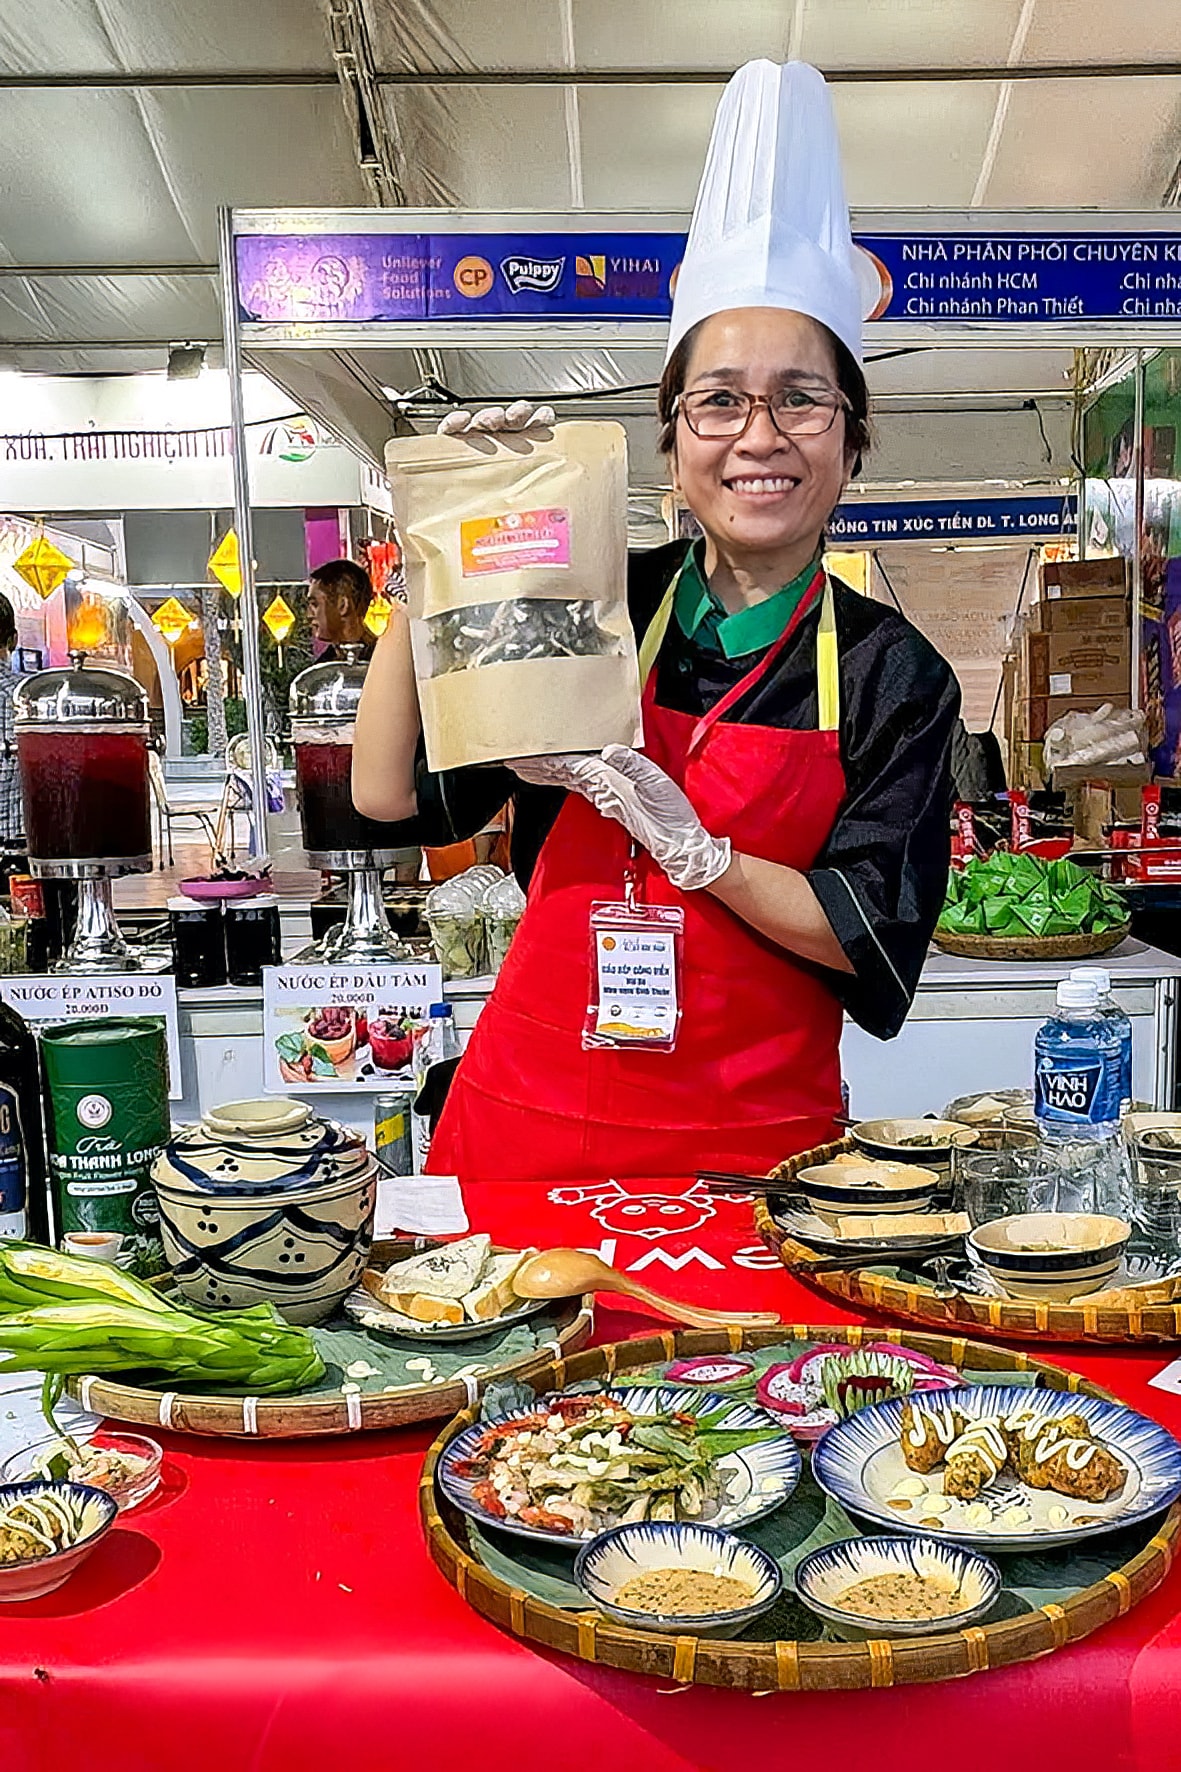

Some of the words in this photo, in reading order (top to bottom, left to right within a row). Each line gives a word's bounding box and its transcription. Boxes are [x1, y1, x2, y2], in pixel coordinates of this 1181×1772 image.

[902, 241, 948, 261] NHÀ
[1073, 241, 1158, 261] CHUYÊN
[1164, 244, 1181, 261] K
[509, 260, 560, 282] Pulppy
[610, 258, 660, 273] YIHAI
[382, 271, 419, 284] Food
[459, 268, 488, 287] CP
[939, 271, 993, 290] nhánh
[997, 271, 1038, 290] HCM
[382, 285, 451, 300] Solutions
[938, 296, 992, 315] nhánh
[997, 296, 1039, 315] Phan
[1042, 295, 1084, 315] Thiết
[872, 519, 898, 533] TIN
[903, 516, 934, 532] XÚC
[938, 510, 972, 531] TIẾN
[977, 514, 996, 530] DL
[1001, 514, 1015, 528] T.
[1019, 512, 1059, 528] LONG
[62, 984, 82, 1000] ÉP
[86, 985, 134, 999] ATISO
[69, 1153, 122, 1170] THANH
